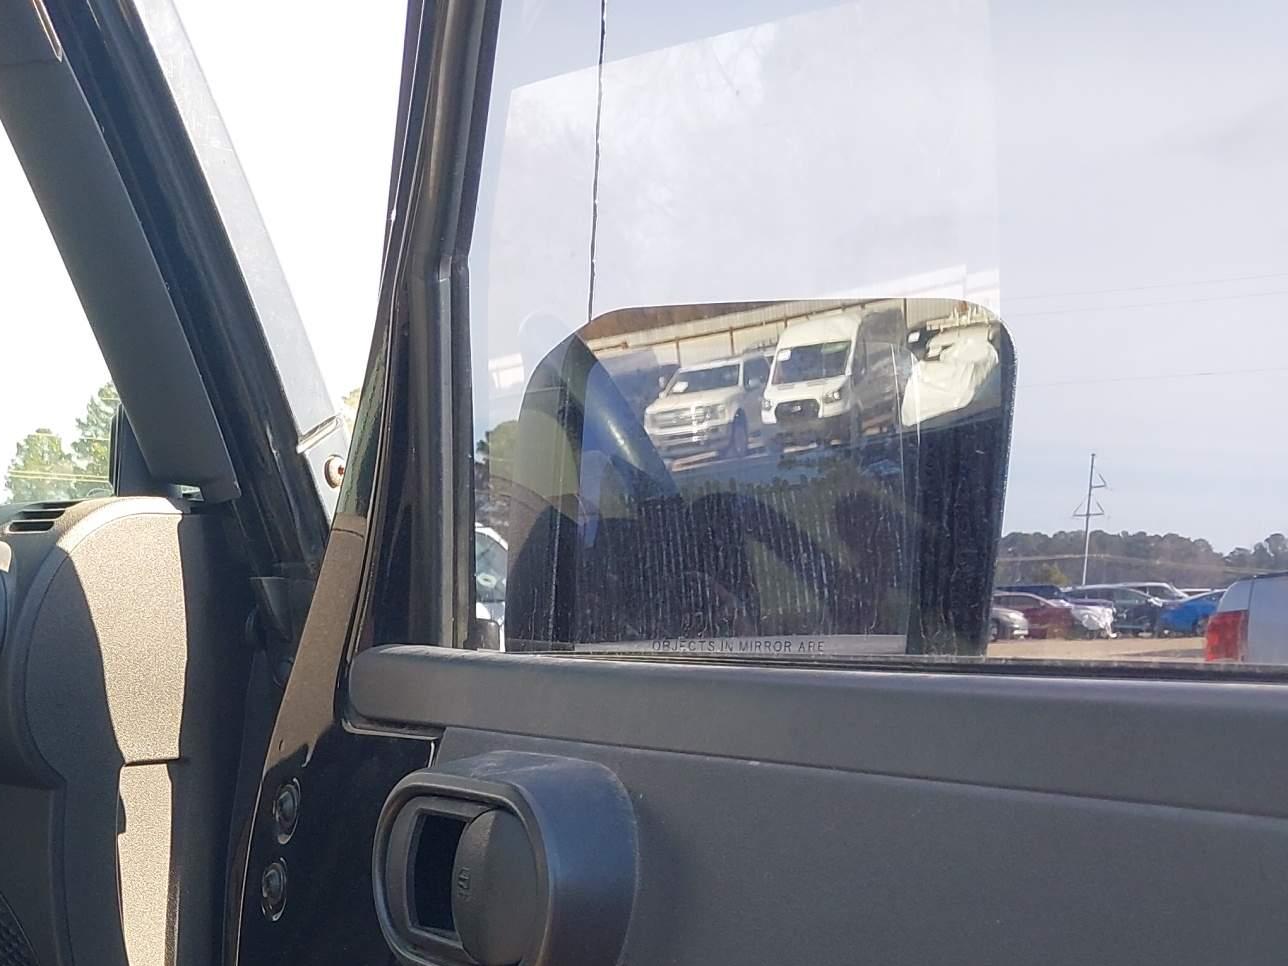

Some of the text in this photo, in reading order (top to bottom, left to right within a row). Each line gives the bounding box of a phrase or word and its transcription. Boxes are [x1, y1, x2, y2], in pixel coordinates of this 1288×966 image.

[720, 639, 733, 652] IN
[739, 640, 792, 652] MIRROR
[798, 641, 825, 653] ARE
